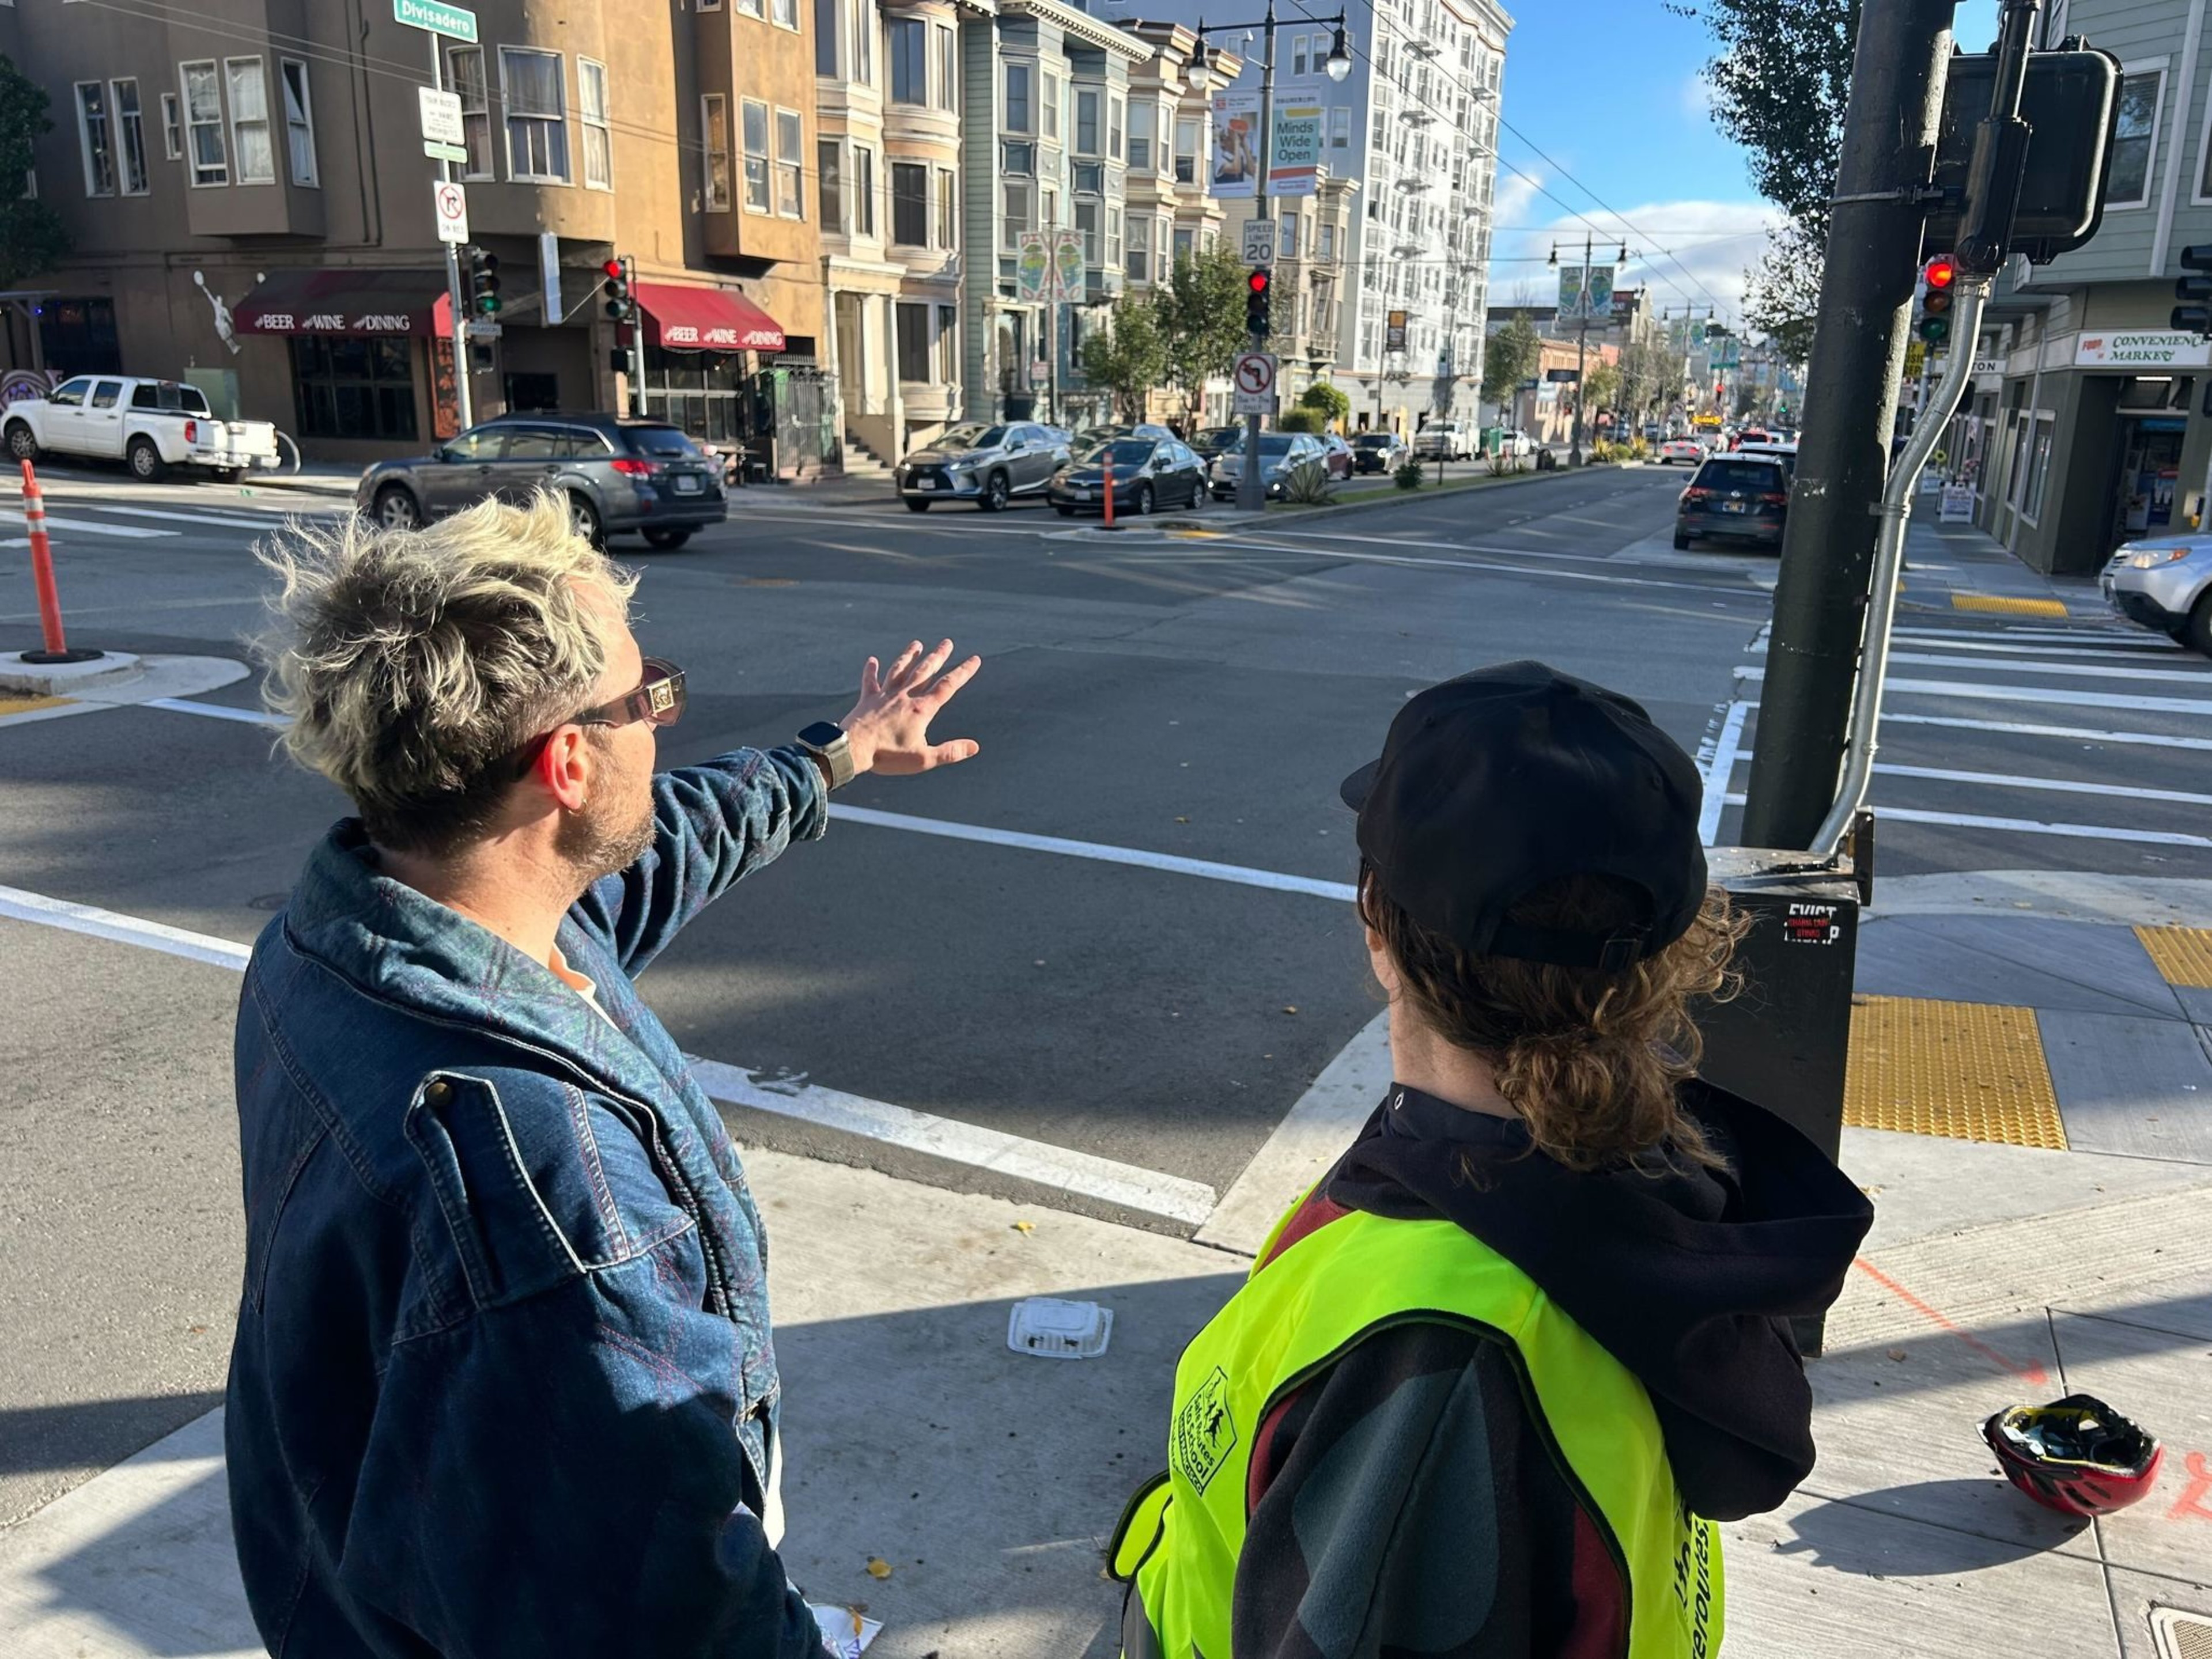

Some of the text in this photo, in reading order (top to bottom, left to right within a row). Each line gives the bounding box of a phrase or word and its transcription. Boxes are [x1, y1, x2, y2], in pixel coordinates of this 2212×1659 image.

[402, 1, 470, 33] Divisadero
[1277, 122, 1314, 134] Minds
[1279, 135, 1311, 147] Wide
[1278, 150, 1310, 163] Open
[1248, 234, 1270, 242] LIMIT
[1246, 244, 1272, 260] 20
[263, 314, 295, 329] BEER
[312, 315, 346, 330] WINE
[365, 315, 410, 331] DINING
[672, 325, 699, 342] BEER
[2110, 350, 2175, 362] MARKET
[1194, 1393, 1216, 1467] Safe Routes
[1186, 1404, 1209, 1479] to School
